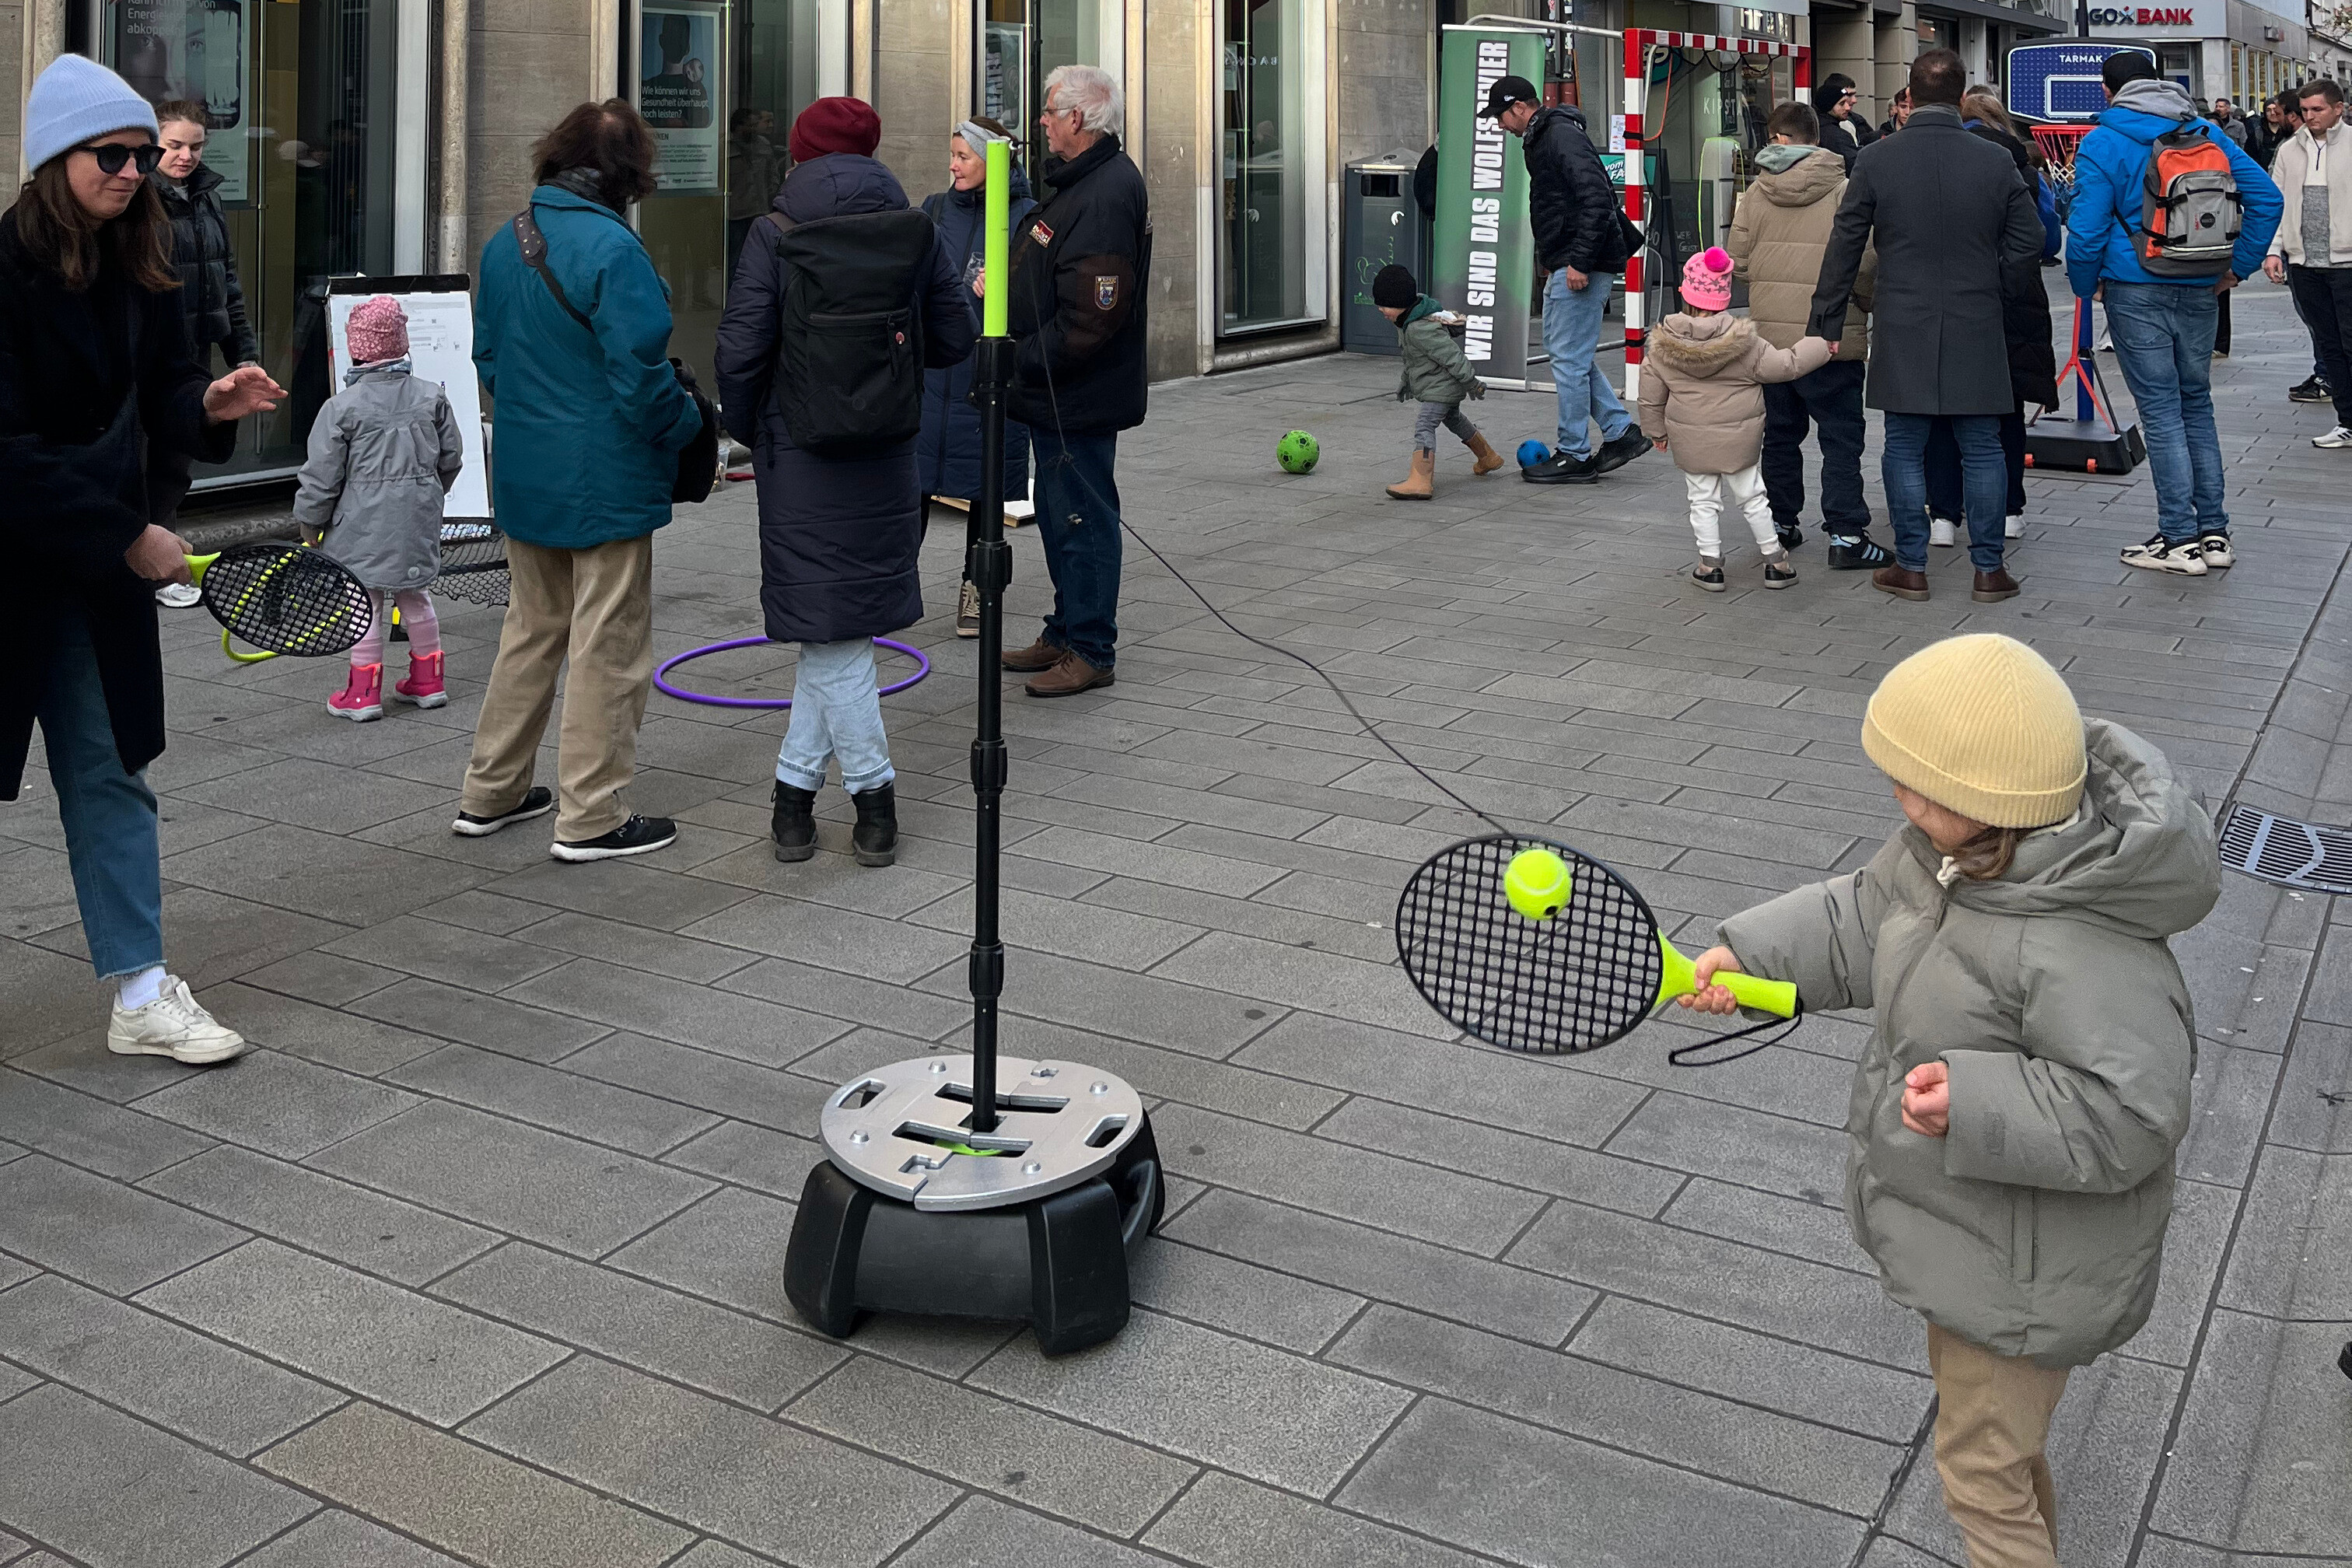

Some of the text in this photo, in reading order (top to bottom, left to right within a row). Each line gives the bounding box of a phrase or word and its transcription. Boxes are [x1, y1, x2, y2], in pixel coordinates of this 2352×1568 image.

[2059, 54, 2103, 63] TARMAK
[655, 86, 677, 95] können
[642, 97, 709, 109] Gesundheit überhaupt
[642, 109, 683, 118] noch leisten?
[1609, 168, 1625, 180] FA
[1470, 198, 1500, 243] DAS
[1467, 251, 1497, 307] SIND
[1465, 314, 1493, 361] WIR
